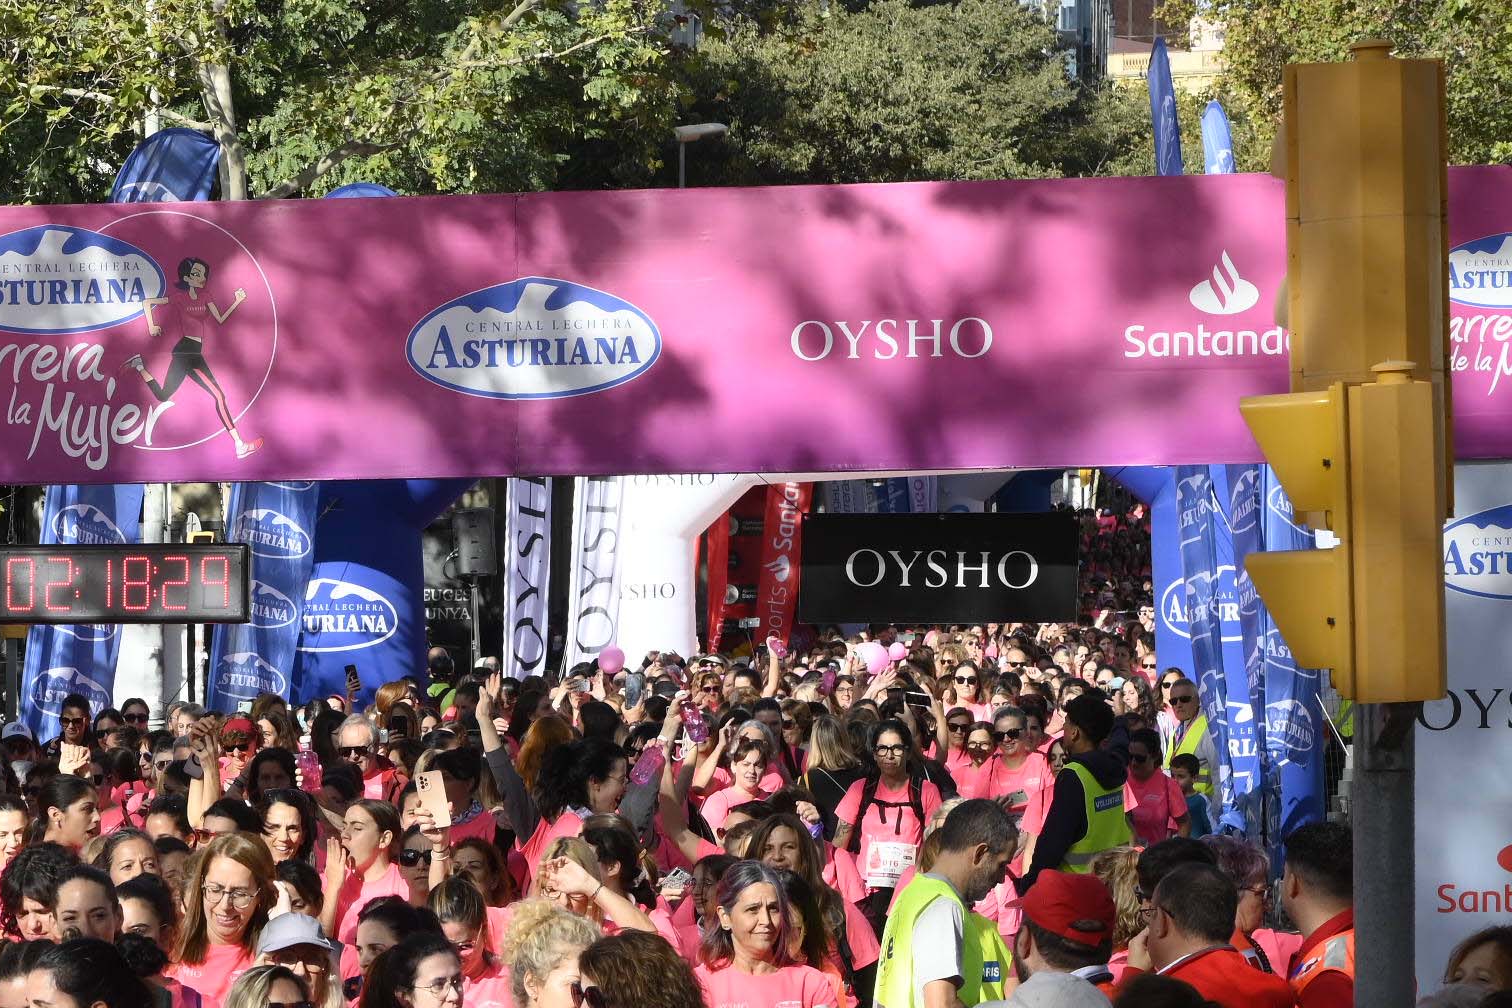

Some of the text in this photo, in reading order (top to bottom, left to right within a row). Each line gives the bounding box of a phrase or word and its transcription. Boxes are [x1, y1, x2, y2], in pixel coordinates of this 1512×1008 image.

[69, 261, 140, 273] LECHERA
[465, 317, 633, 333] CENTRAL LECHERA
[790, 316, 993, 361] OYSHO
[426, 325, 641, 369] ASTURIANA
[1475, 344, 1492, 372] la
[7, 386, 31, 425] la
[27, 377, 175, 470] Mujer
[1472, 537, 1511, 546] CENT
[513, 477, 546, 671] OYSH
[576, 476, 618, 654] OYSH
[844, 548, 1039, 590] OYSHO
[6, 556, 228, 611] 02:18:29
[252, 602, 288, 622] RIANA
[303, 614, 388, 633] TURIANA
[335, 603, 384, 612] LECHERA
[424, 607, 472, 620] UNYA
[767, 586, 787, 641] ports
